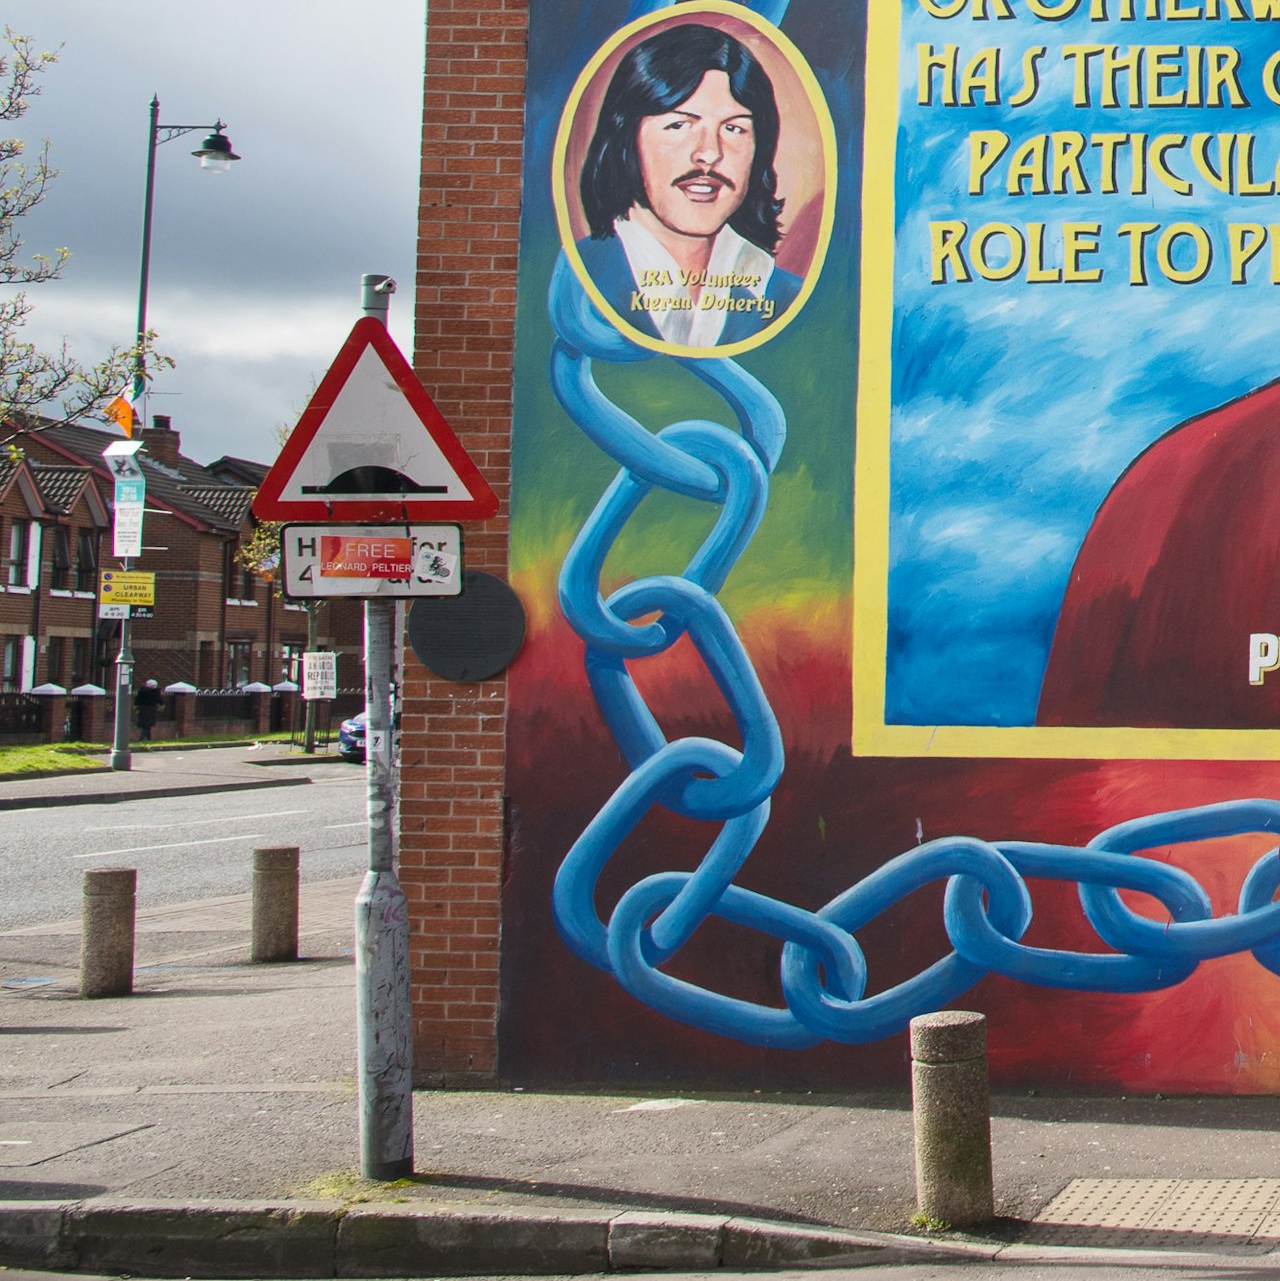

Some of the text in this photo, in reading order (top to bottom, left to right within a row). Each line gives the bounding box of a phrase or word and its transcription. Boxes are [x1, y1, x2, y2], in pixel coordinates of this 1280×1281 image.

[917, 44, 1047, 108] HAS
[1064, 45, 1250, 108] THEIR
[930, 221, 1102, 285] ROLE
[1118, 221, 1213, 286] TO
[677, 269, 761, 287] Volunteer
[630, 290, 776, 320] Kieran Doherty
[345, 543, 396, 559] FREE
[321, 561, 412, 574] LEONARD PELTIER
